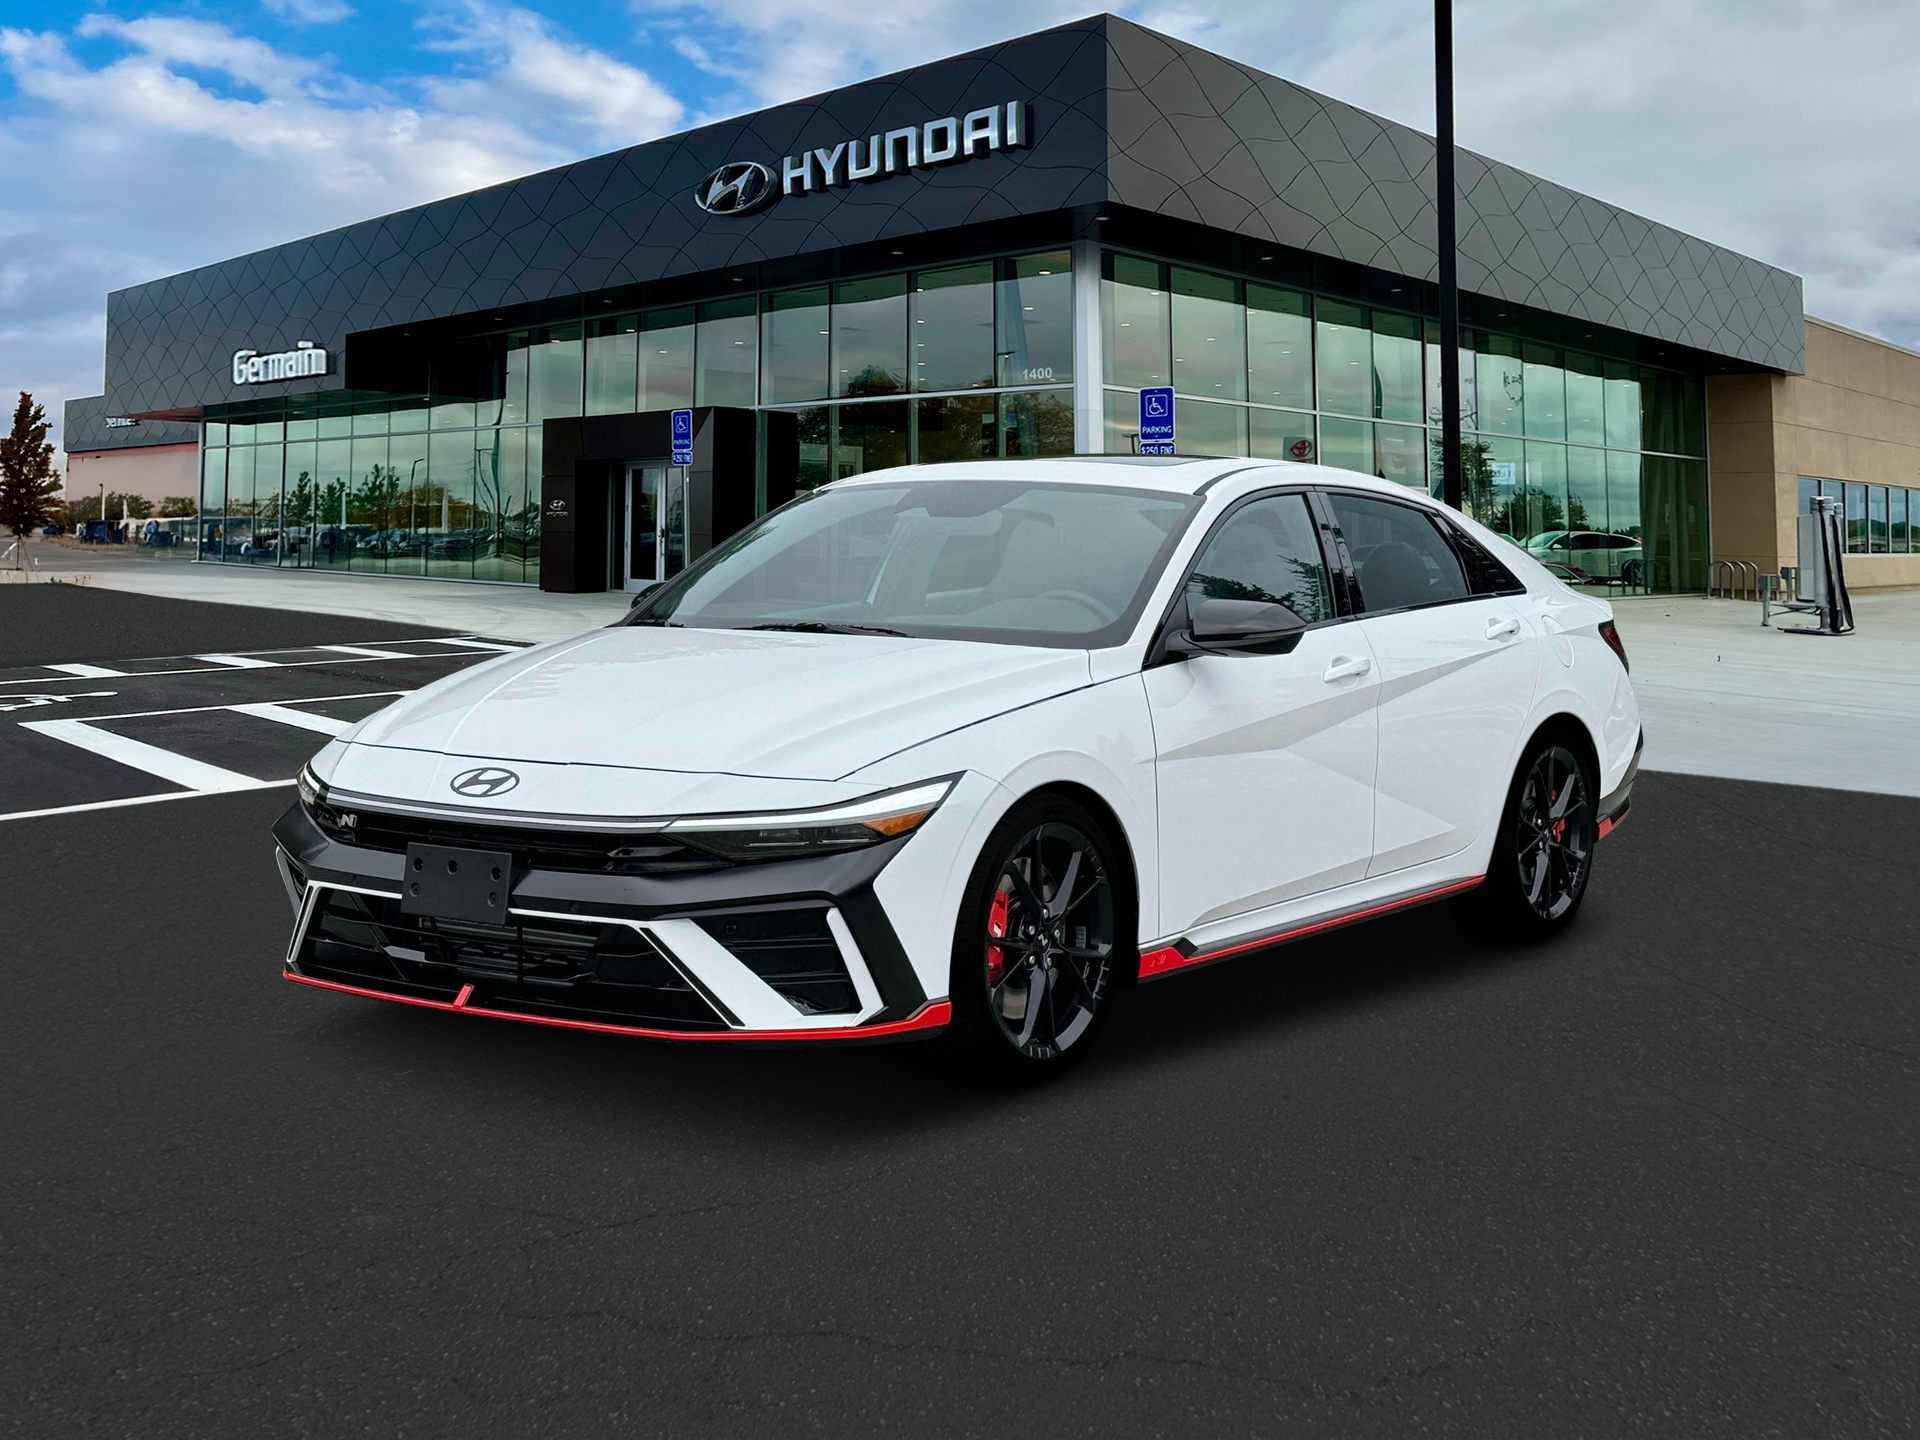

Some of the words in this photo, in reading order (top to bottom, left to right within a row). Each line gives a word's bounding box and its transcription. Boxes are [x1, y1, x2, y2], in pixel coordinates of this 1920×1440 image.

[782, 100, 1025, 195] HYUNDAI
[233, 340, 327, 385] Germain
[1022, 367, 1052, 380] 1400
[1141, 425, 1173, 434] PARKING
[1141, 446, 1158, 454] $250
[1160, 446, 1173, 454] FINE
